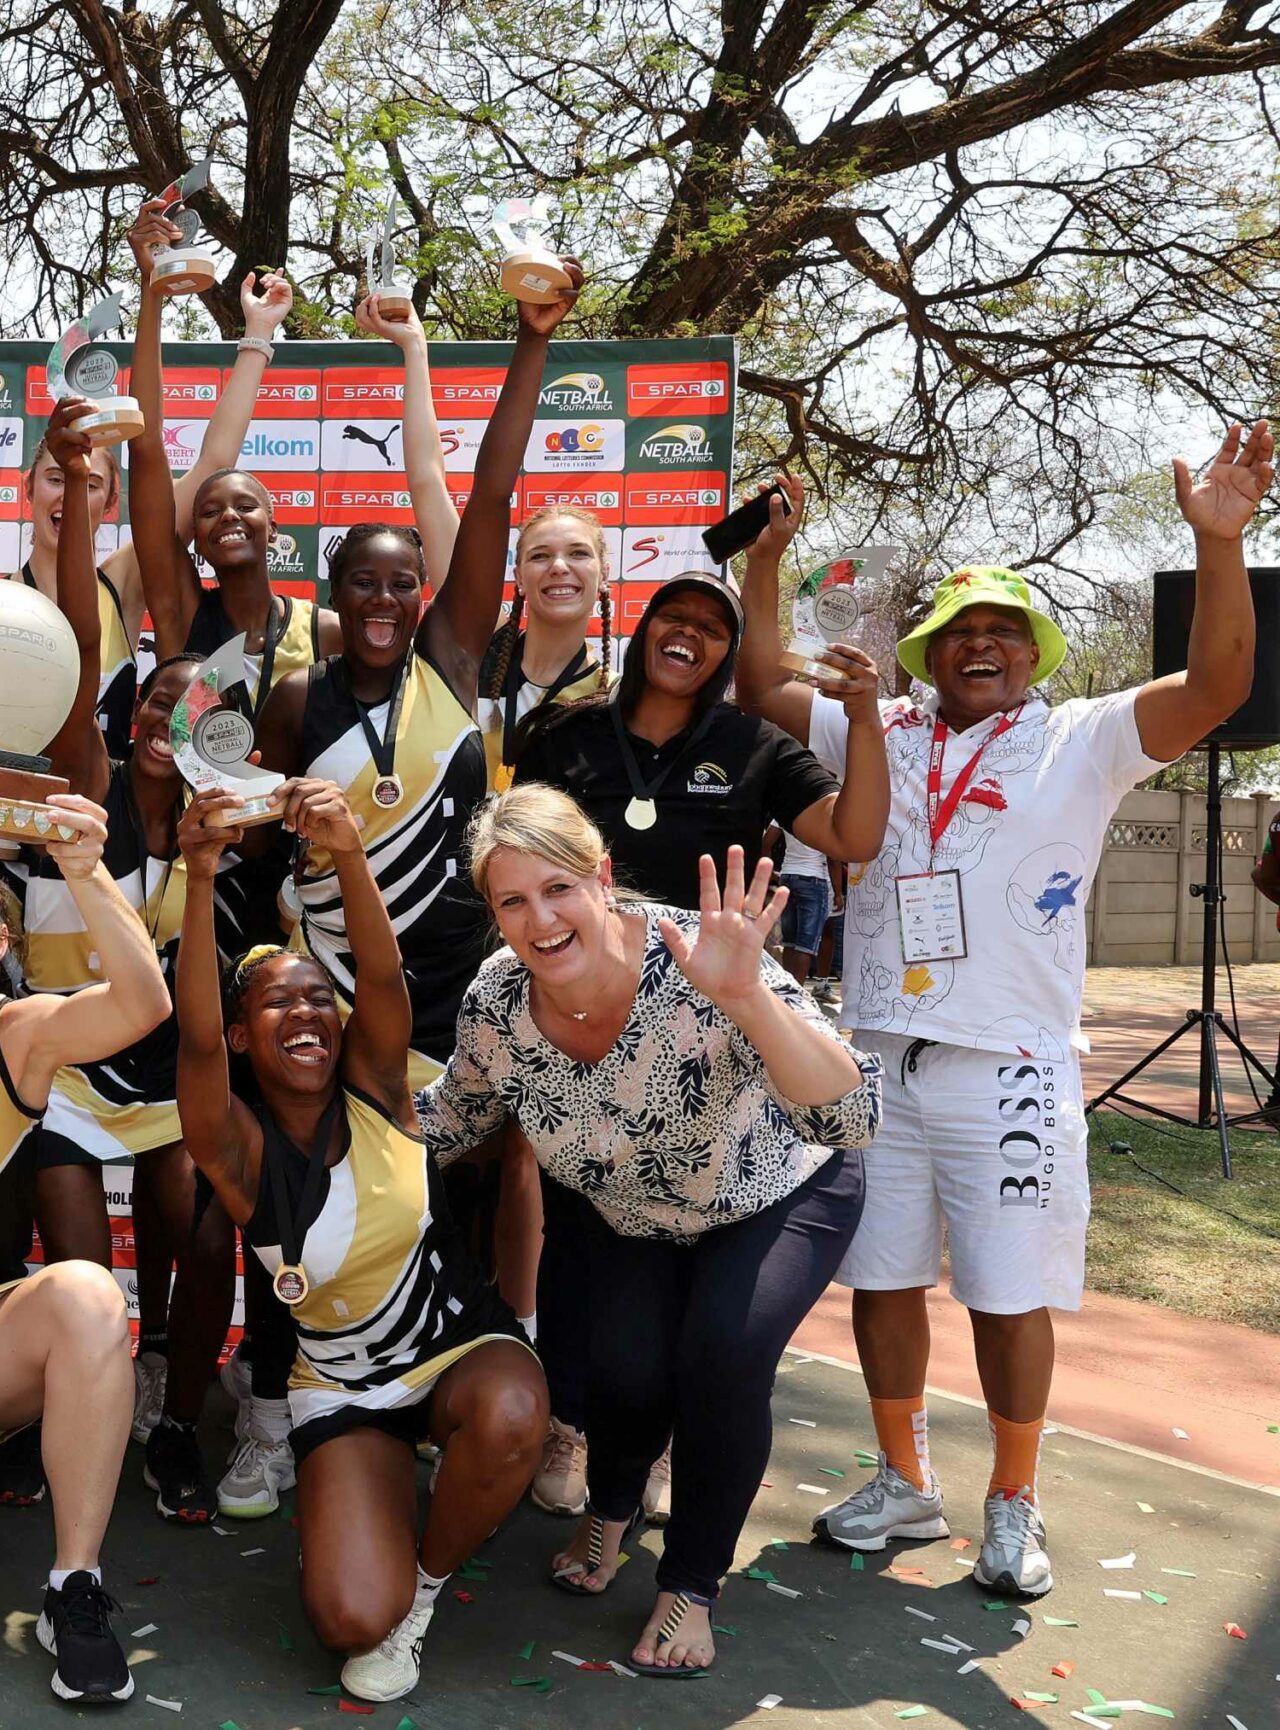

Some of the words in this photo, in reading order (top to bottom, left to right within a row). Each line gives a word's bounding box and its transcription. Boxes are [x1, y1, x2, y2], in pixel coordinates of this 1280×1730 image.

[256, 388, 294, 398] PAR
[343, 388, 395, 398] SPAR
[444, 388, 496, 398] SPAR
[648, 383, 701, 396] SPAR
[537, 390, 613, 405] NETBALL
[240, 434, 313, 456] elkom
[639, 442, 714, 458] NETBALL
[659, 456, 686, 464] SOUTH
[687, 455, 713, 464] AFRICA
[269, 493, 293, 503] AR
[341, 493, 392, 504] SPAR
[448, 495, 468, 505] SP
[544, 493, 596, 504] SPAR
[646, 492, 698, 504] SPAR
[266, 552, 304, 567] BALL
[277, 565, 304, 573] AFRICA
[212, 720, 235, 731] 2023
[211, 740, 243, 753] NETBALL
[1043, 1066, 1056, 1128] BOSS
[997, 1065, 1042, 1209] BOSS
[1040, 1145, 1055, 1209] HUGO
[111, 1236, 135, 1247] SP
